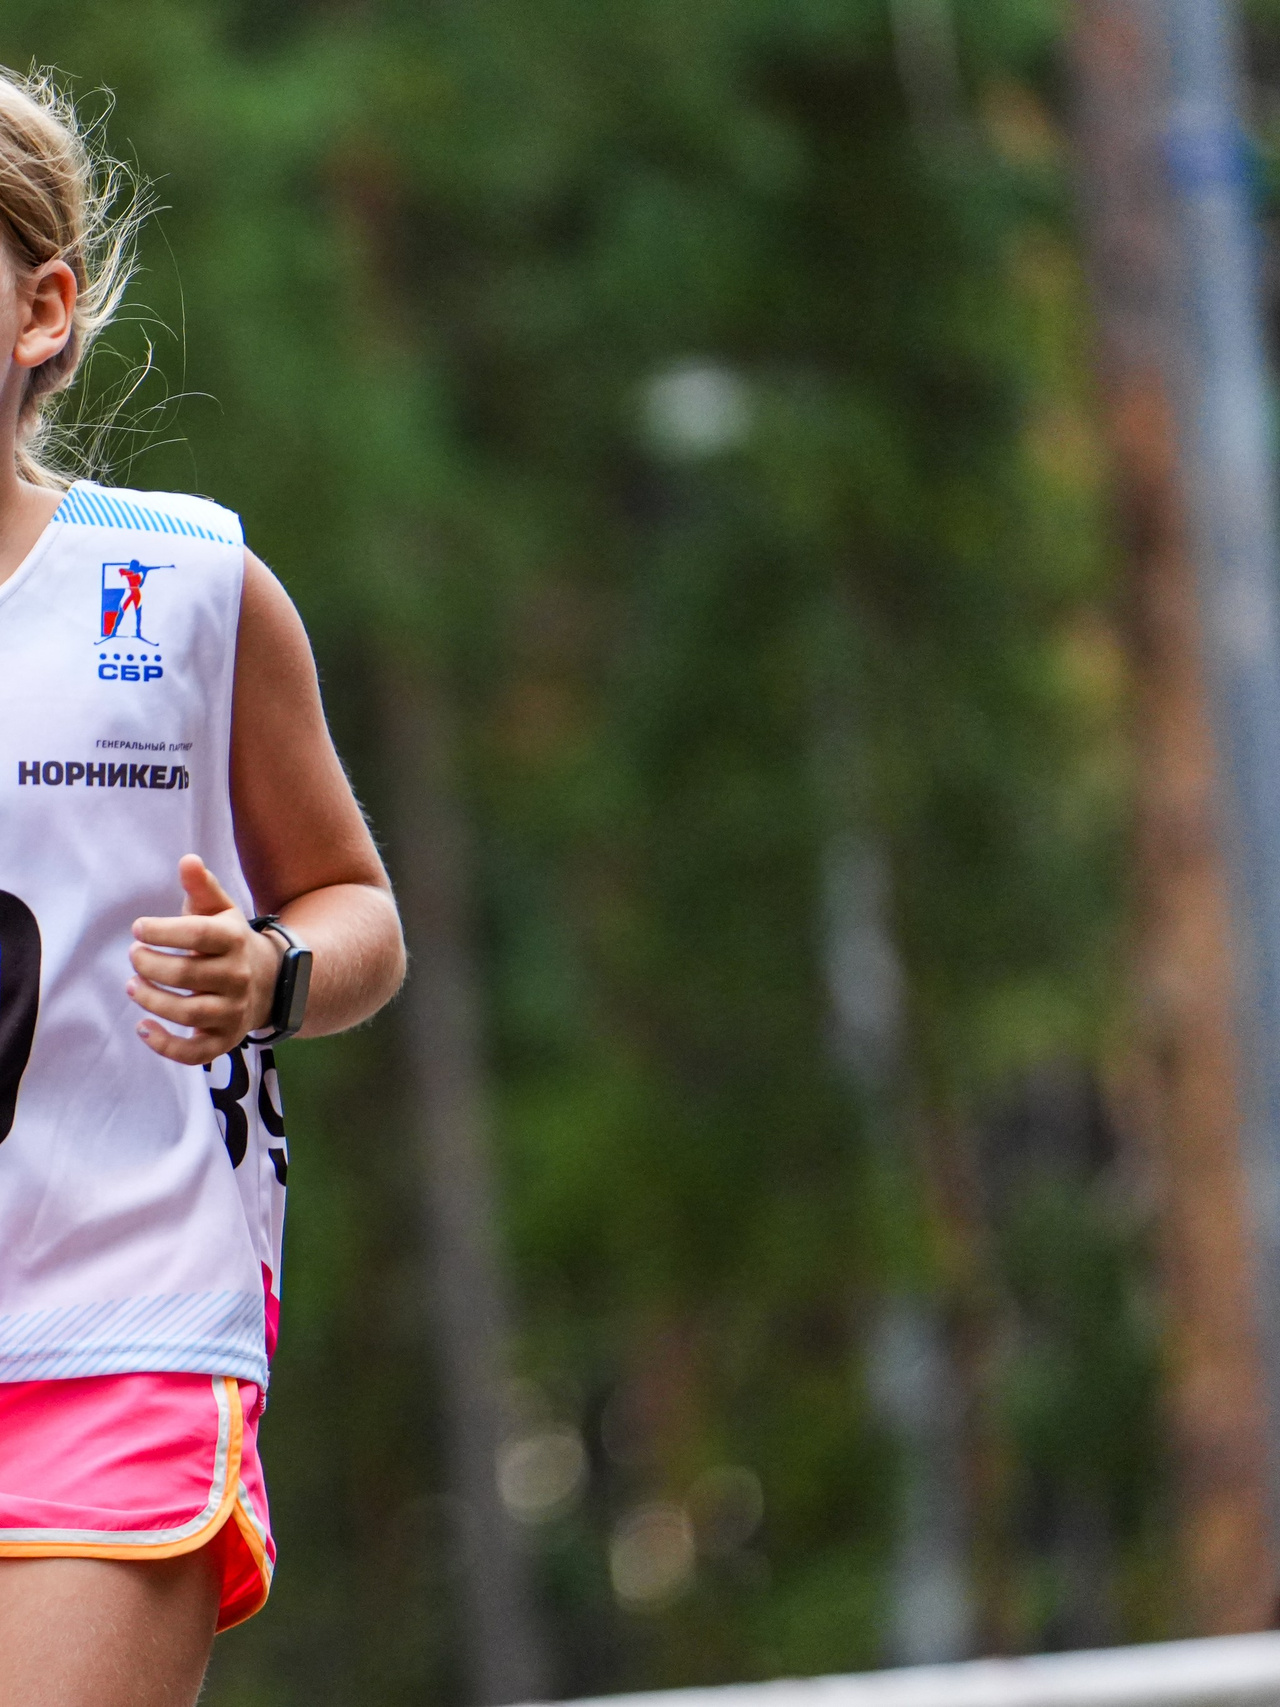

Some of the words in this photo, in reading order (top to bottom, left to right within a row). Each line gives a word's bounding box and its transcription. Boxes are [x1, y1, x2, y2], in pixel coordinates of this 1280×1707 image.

[98, 663, 163, 682] СБР
[96, 740, 166, 752] ГЕНЕРАЛЬНЫЙ
[18, 760, 190, 790] НОРНИКЕЛЬ
